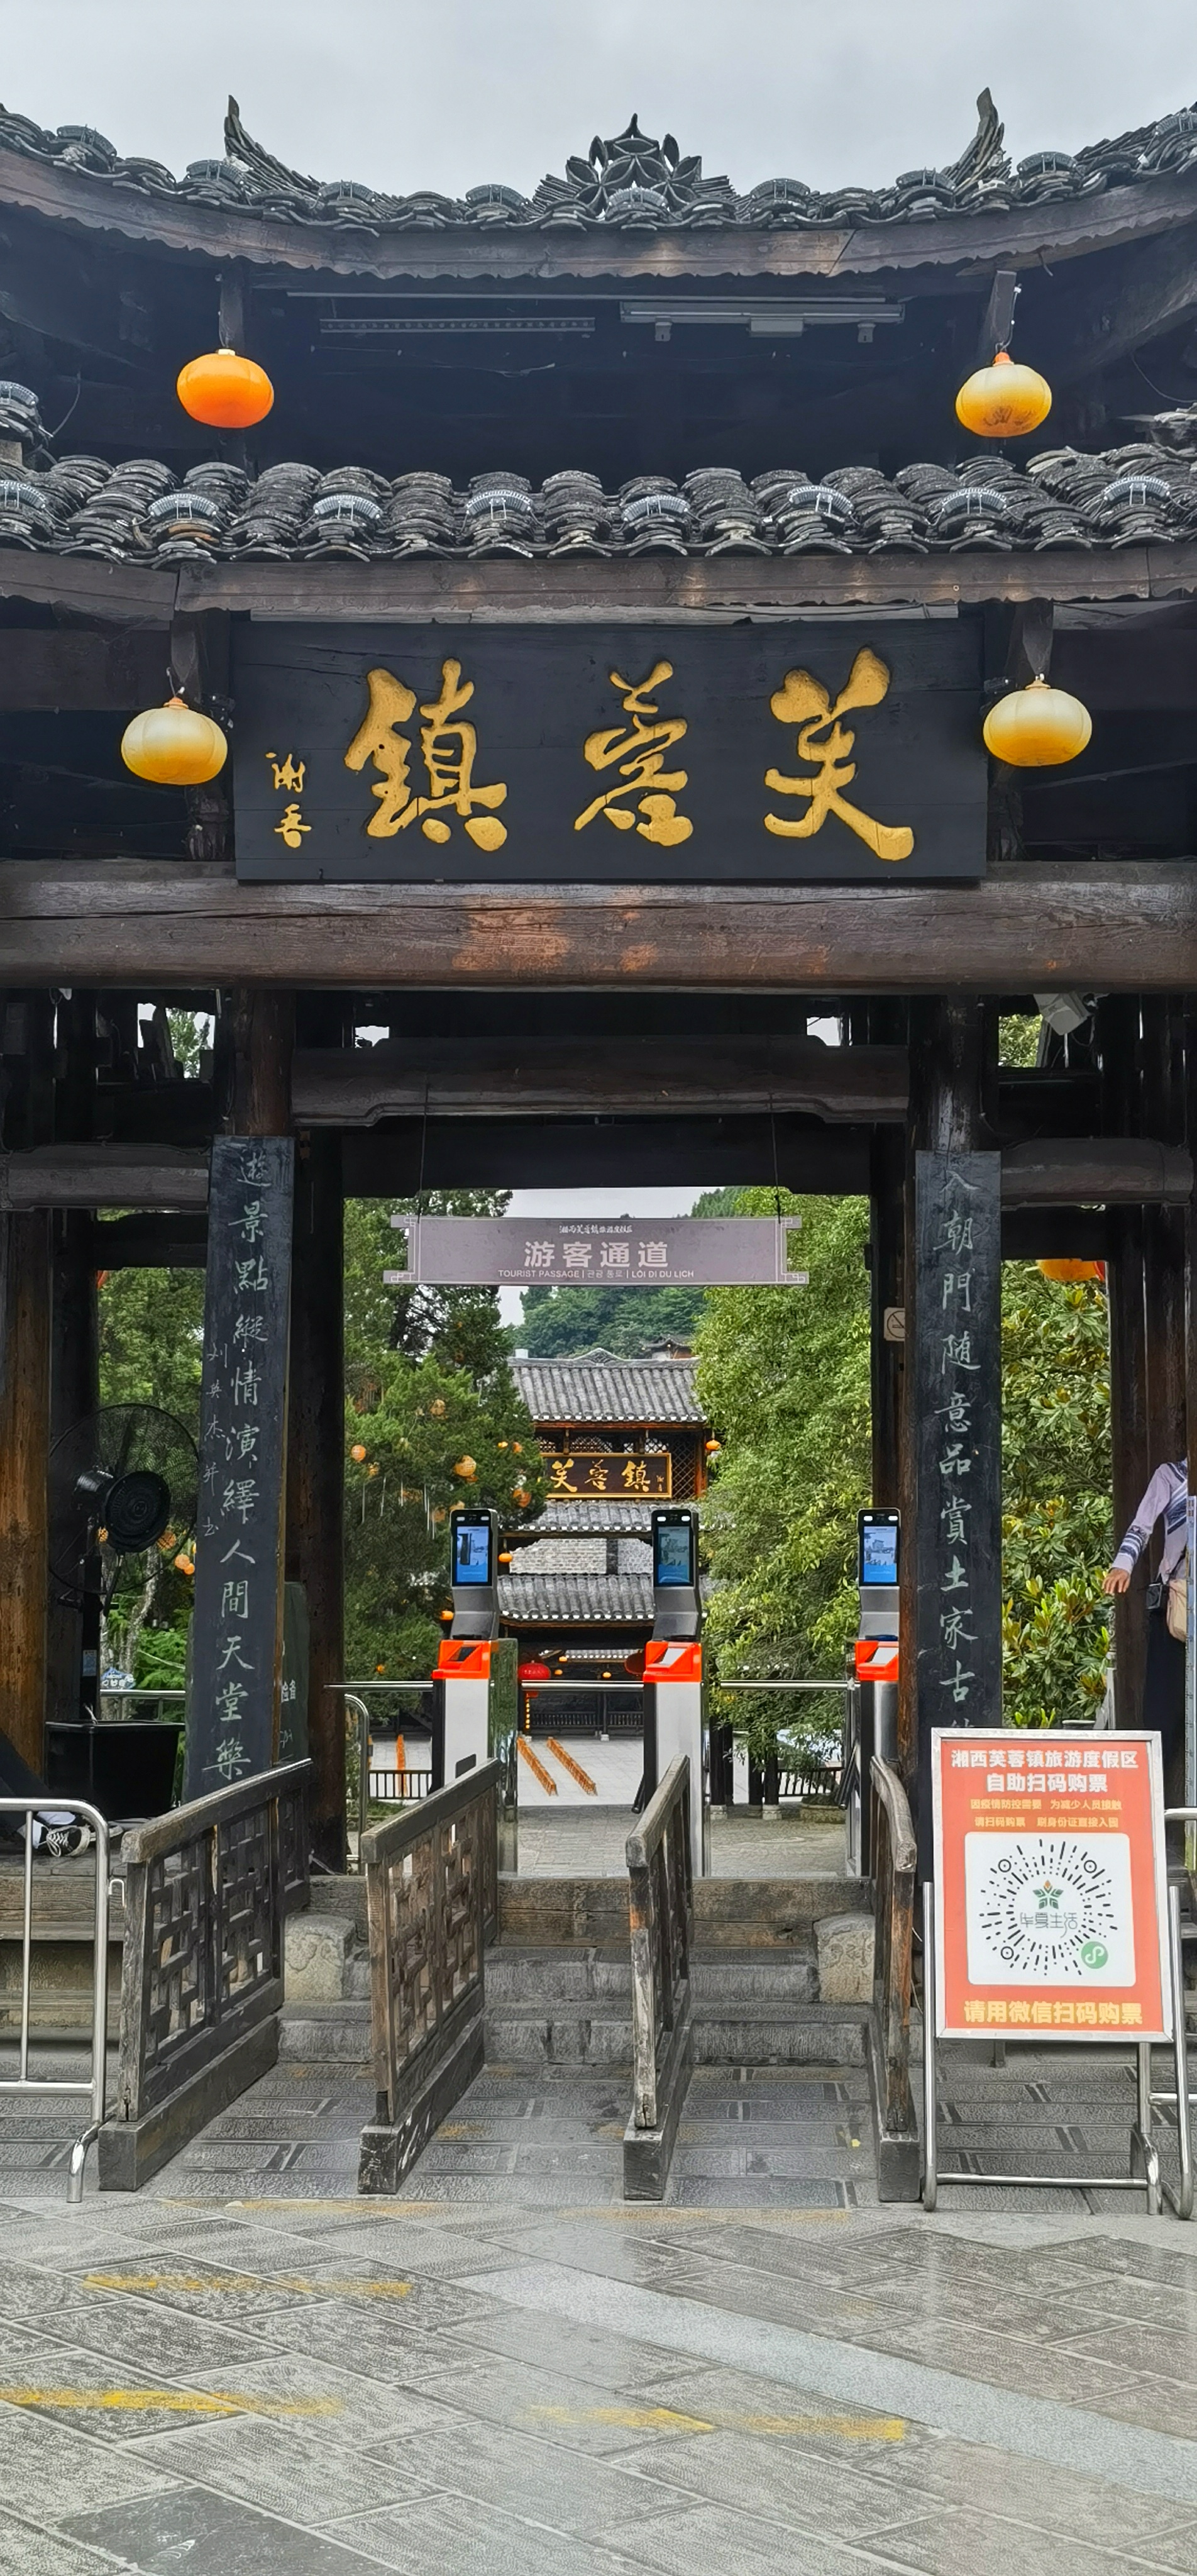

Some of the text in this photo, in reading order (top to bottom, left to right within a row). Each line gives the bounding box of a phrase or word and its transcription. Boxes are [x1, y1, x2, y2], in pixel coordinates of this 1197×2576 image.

[524, 1241, 668, 1267] 游客通道
[539, 1270, 579, 1278] PASSAGE
[933, 1170, 981, 1728] 入朝門随意品賞土家古
[951, 1749, 1139, 1768] 湘西芙蓉镇旅游度假区
[986, 1774, 1108, 1793] 自助扫码购票
[970, 1799, 1123, 1811] 因疫情防控需要 为减少人员接触
[974, 1816, 1025, 1828] 请扫码购票
[1020, 1912, 1078, 1938] 华夏生活
[964, 2000, 1143, 2024] 请用微信扫码购票
